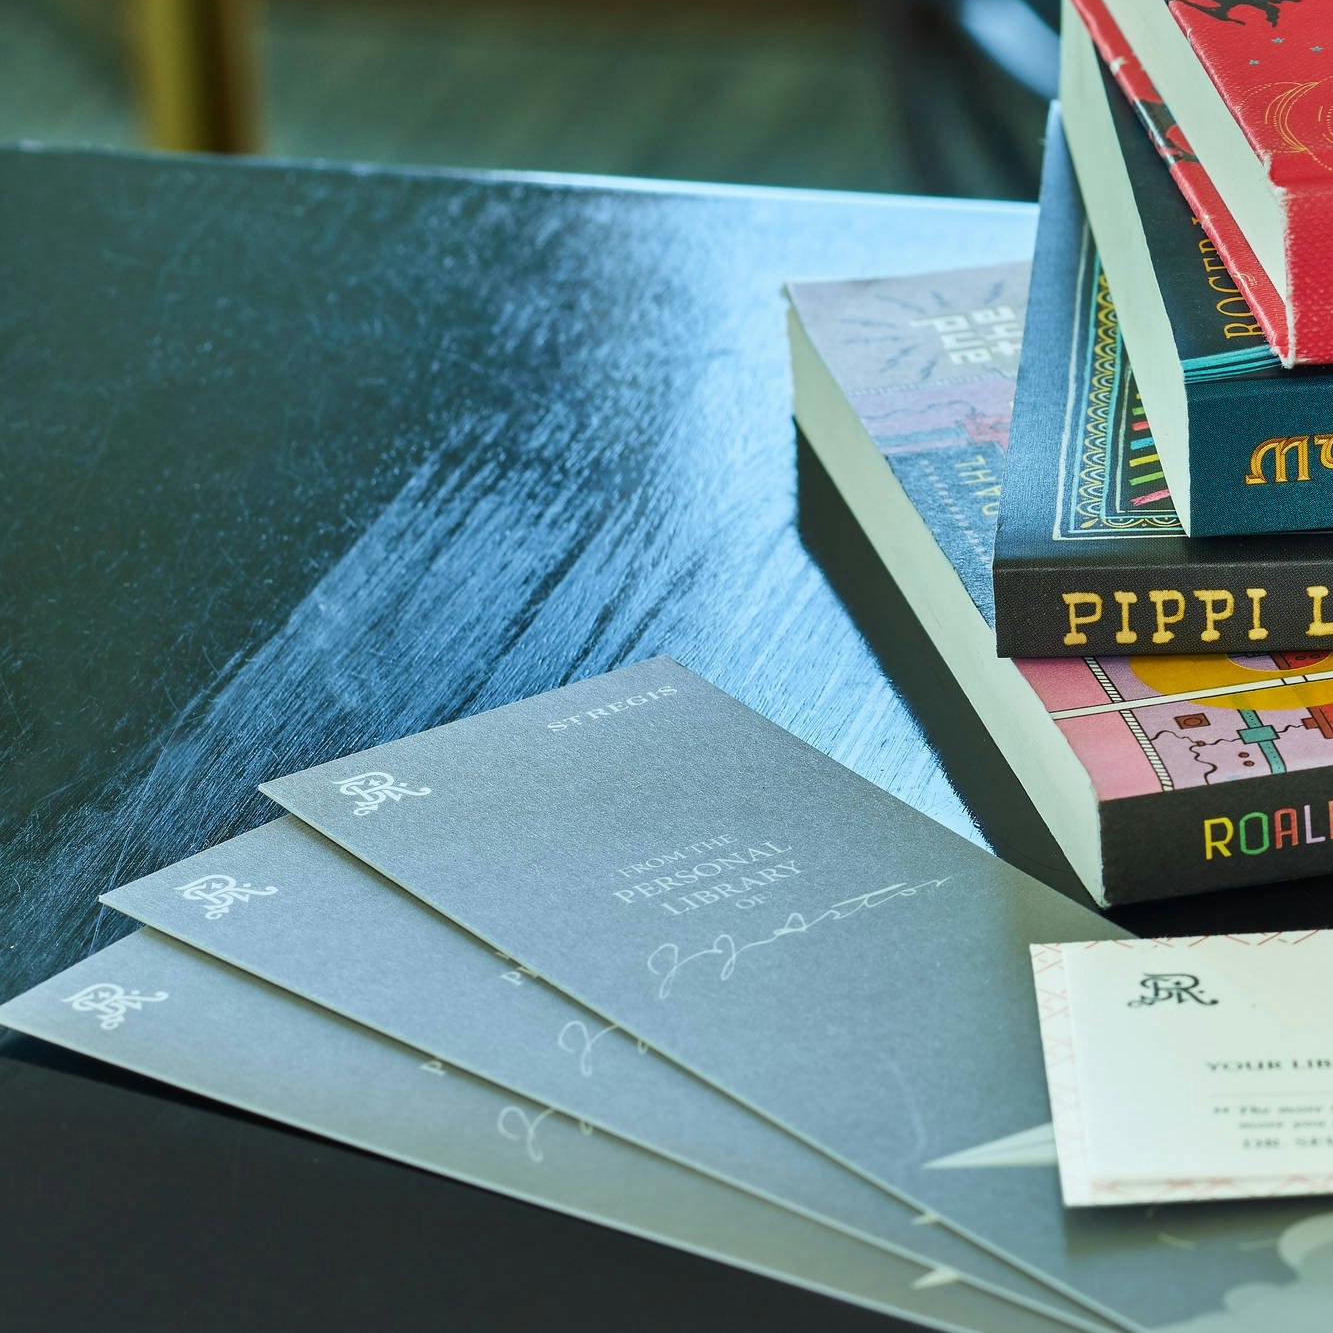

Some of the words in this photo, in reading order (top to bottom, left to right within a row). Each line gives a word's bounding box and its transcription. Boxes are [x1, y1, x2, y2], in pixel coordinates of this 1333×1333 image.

[1062, 586, 1270, 646] PIPPI
[589, 684, 679, 722] REGIS
[612, 839, 793, 906] PERSONAL
[619, 849, 685, 879] FROM
[683, 832, 738, 856] THE
[659, 858, 803, 917] LIBRARY
[734, 890, 766, 911] OF
